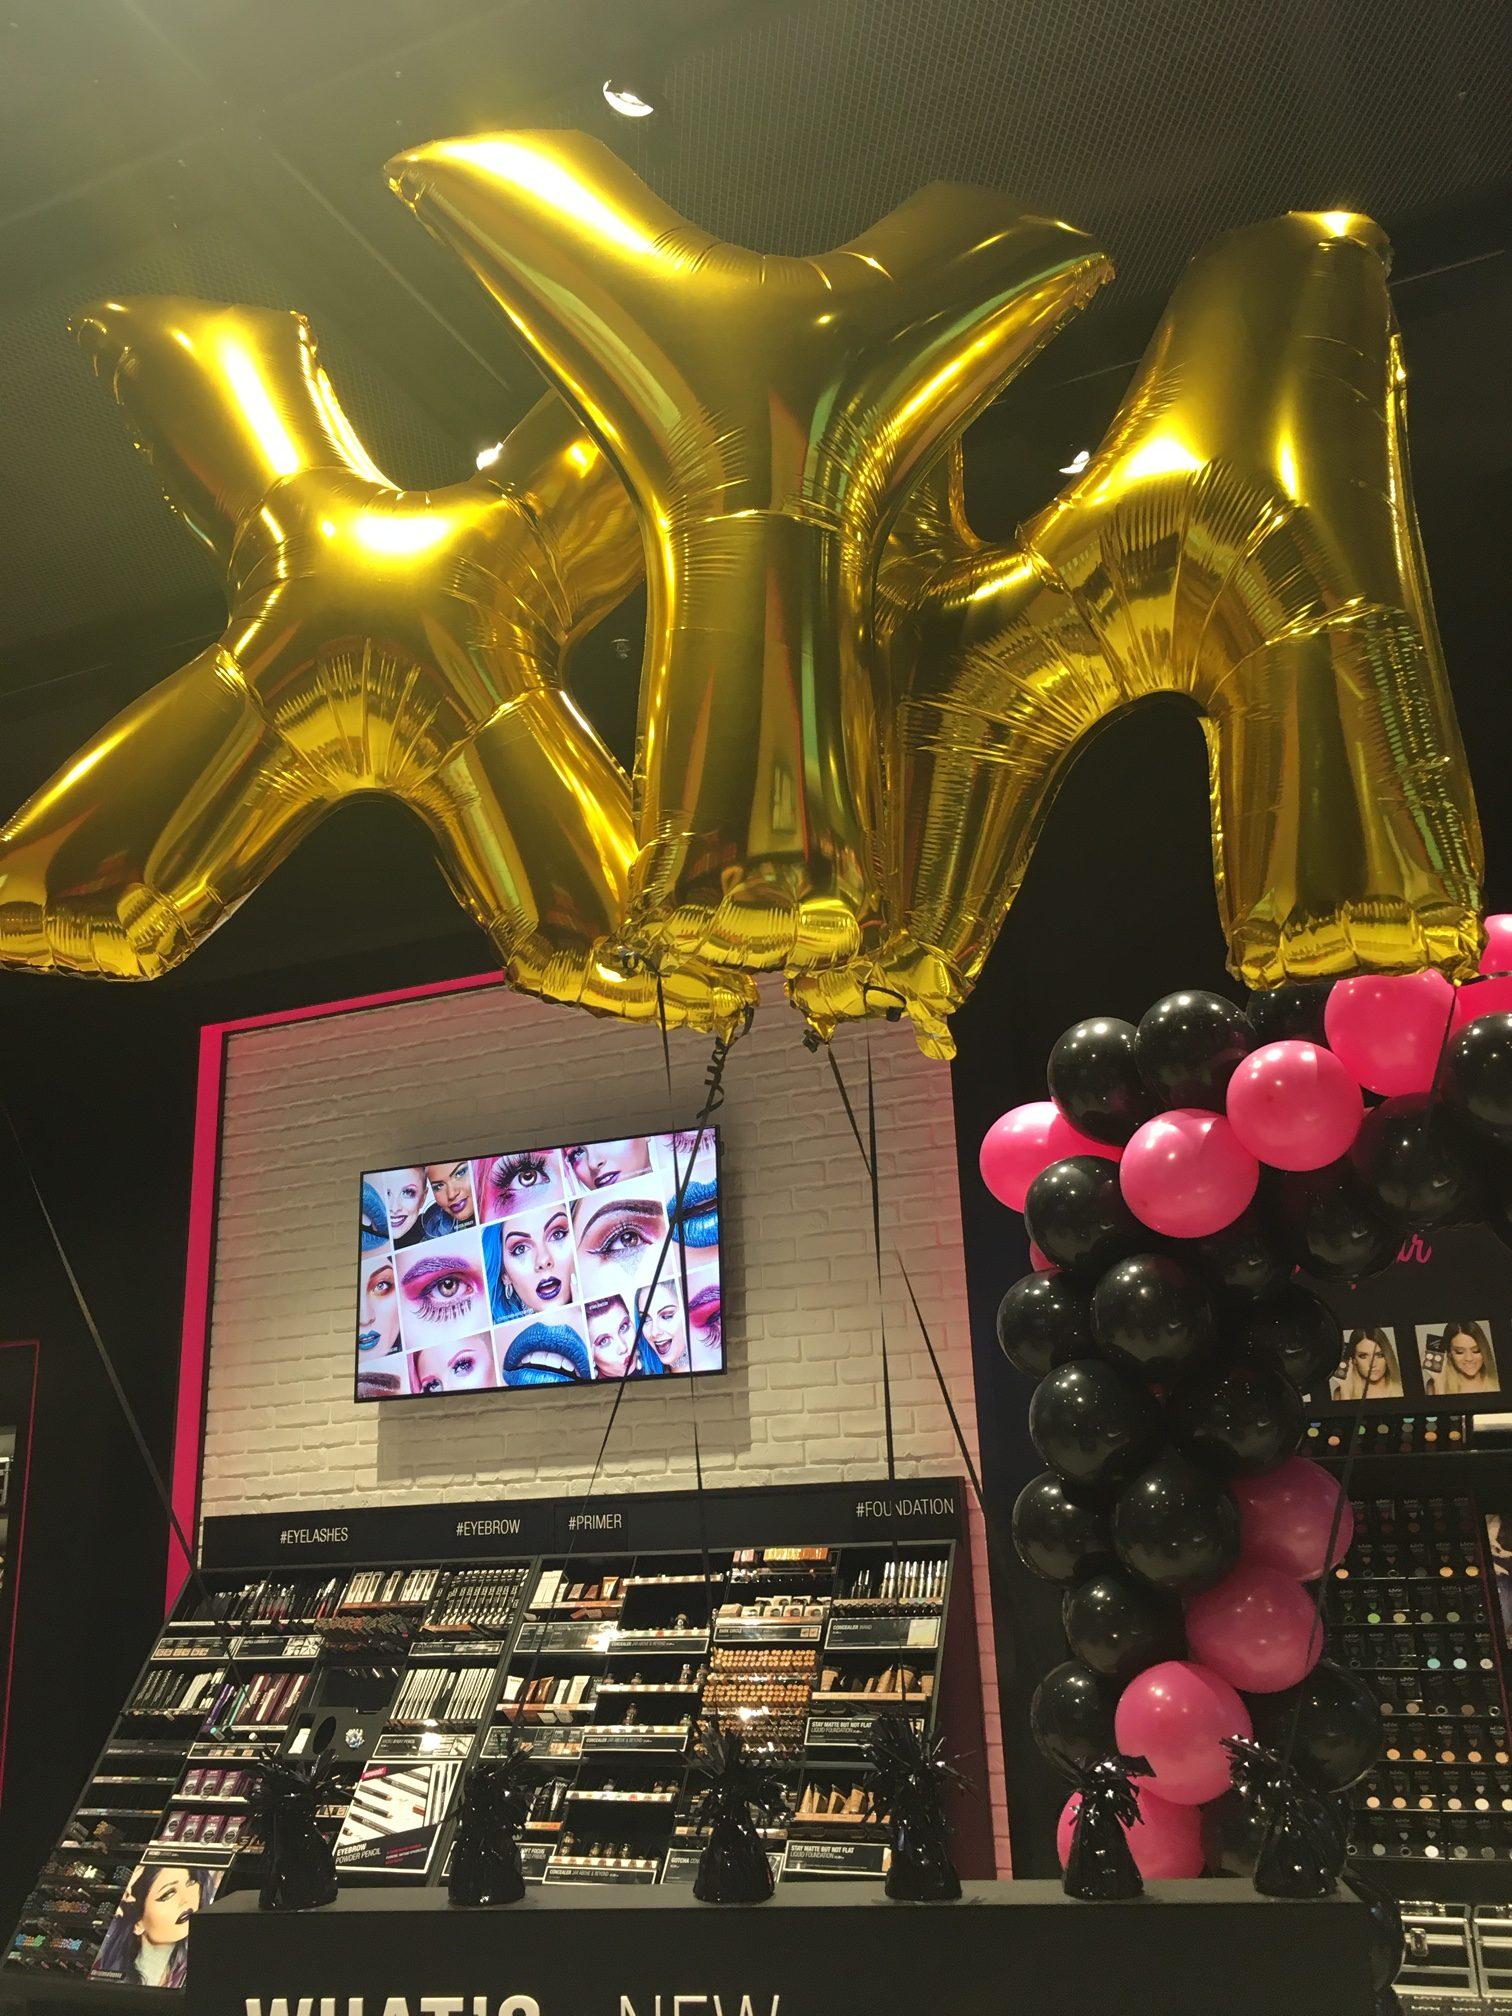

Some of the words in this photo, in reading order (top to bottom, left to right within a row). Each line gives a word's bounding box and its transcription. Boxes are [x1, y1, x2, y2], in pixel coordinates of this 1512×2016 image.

[856, 1498, 955, 1518] #FOUNDATION
[456, 1519, 521, 1536] #EYEBROW
[568, 1513, 622, 1530] #PRIMER
[280, 1527, 349, 1544] #EYELASHES
[335, 1852, 361, 1864] POWDER
[361, 1847, 381, 1859] PENCIL
[337, 1843, 367, 1857] EYEBROW
